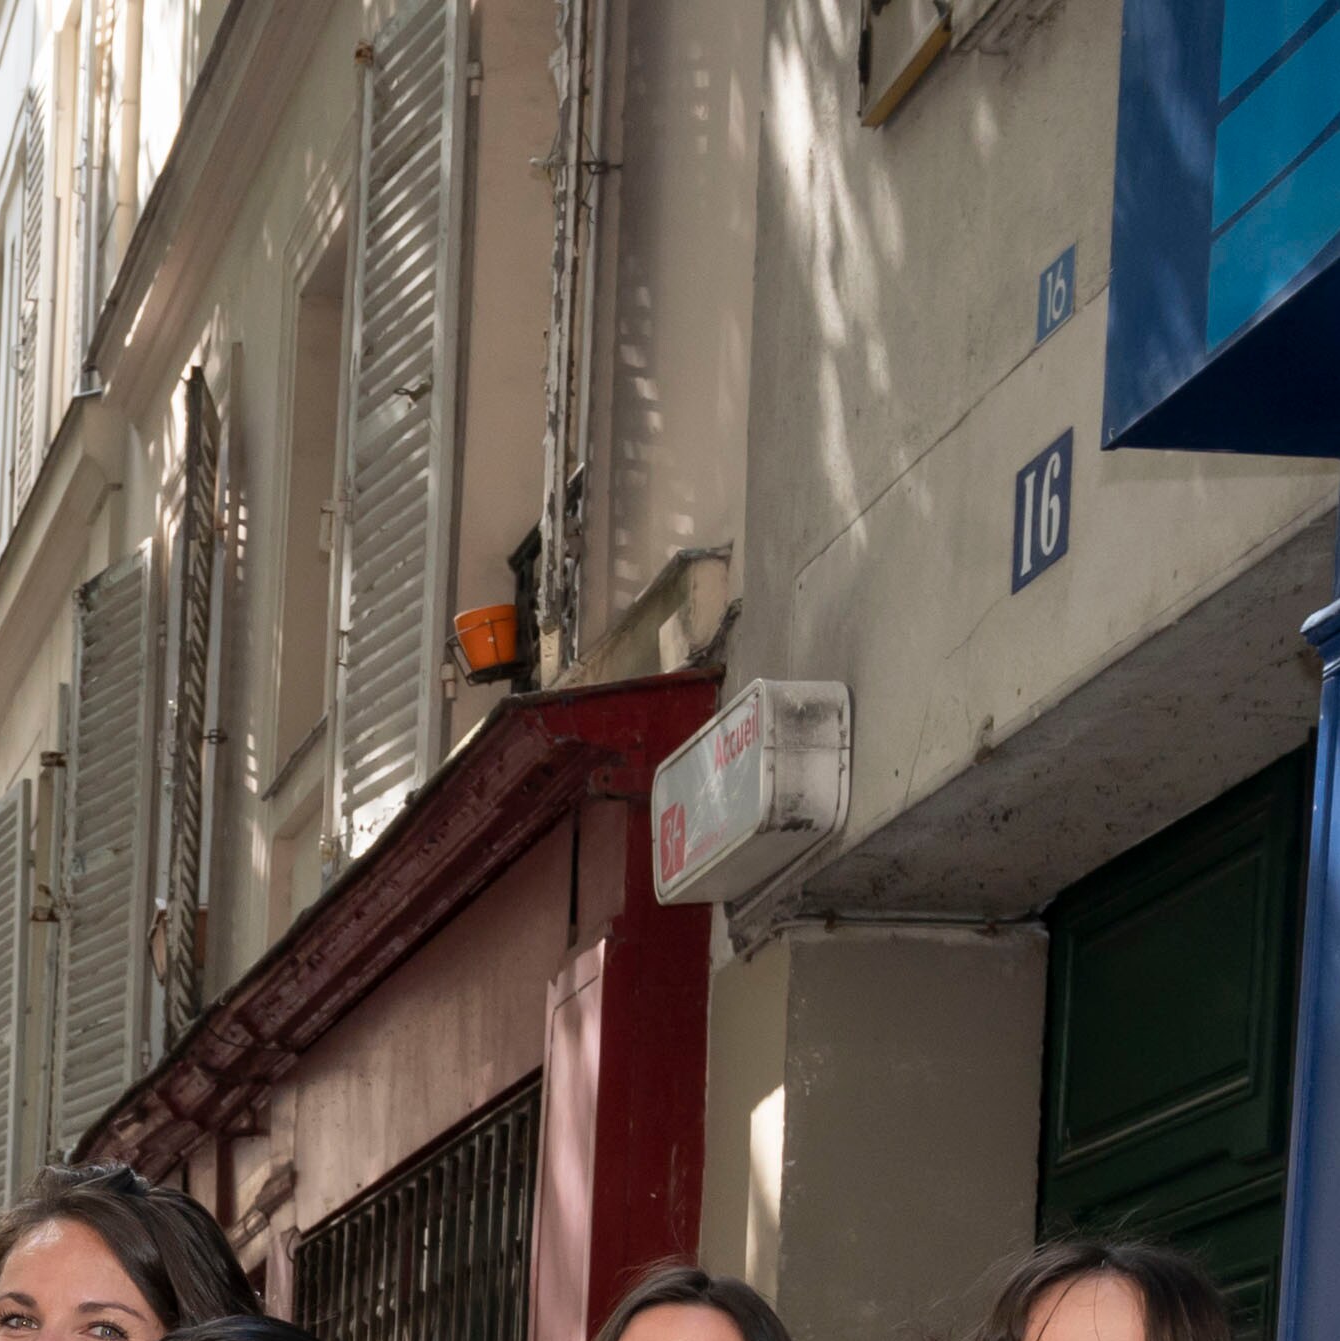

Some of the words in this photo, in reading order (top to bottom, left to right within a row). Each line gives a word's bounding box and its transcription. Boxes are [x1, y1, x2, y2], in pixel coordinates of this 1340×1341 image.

[1045, 267, 1067, 329] 16
[1019, 451, 1062, 578] 16
[714, 701, 760, 774] Accueil
